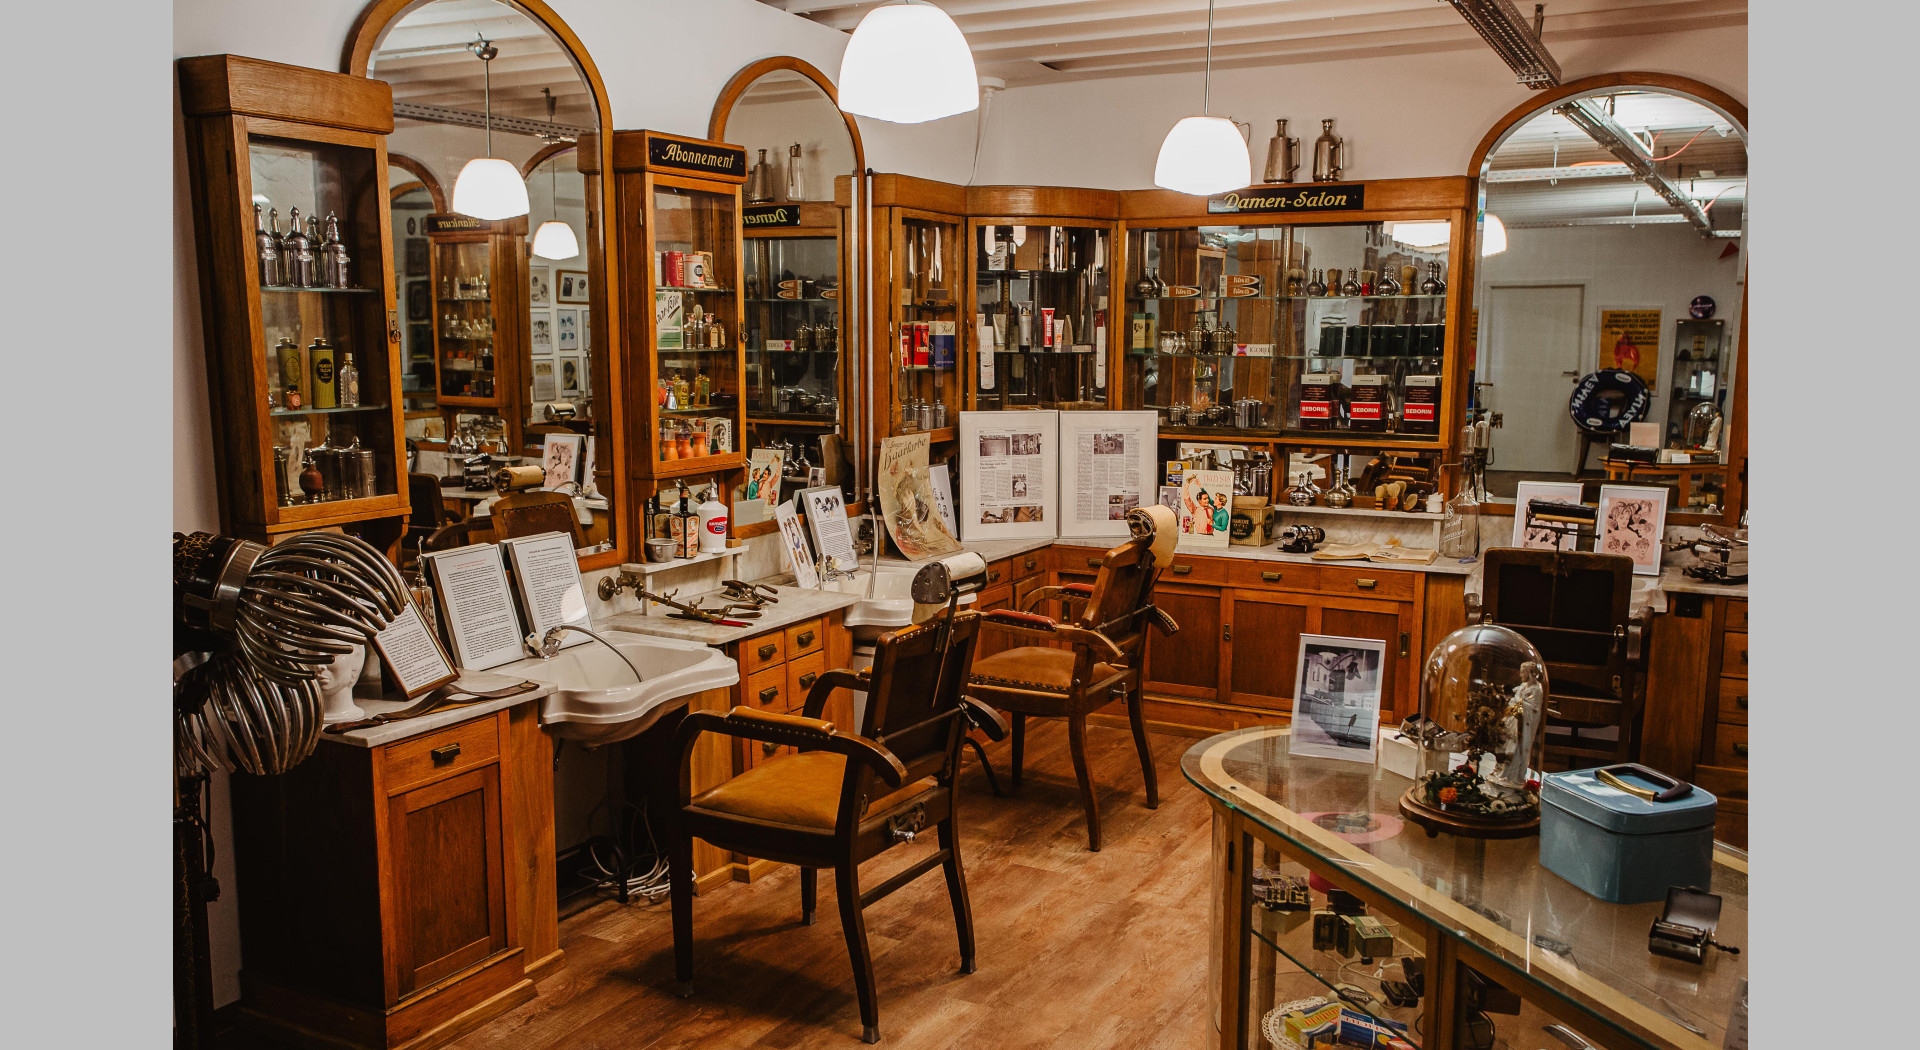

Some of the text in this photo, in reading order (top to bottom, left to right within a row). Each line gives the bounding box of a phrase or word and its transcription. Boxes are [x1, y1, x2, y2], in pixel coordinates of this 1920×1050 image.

[661, 143, 734, 169] Abonnement
[1223, 191, 1347, 209] Damen-Salon
[1304, 1008, 1340, 1027] unlicht
